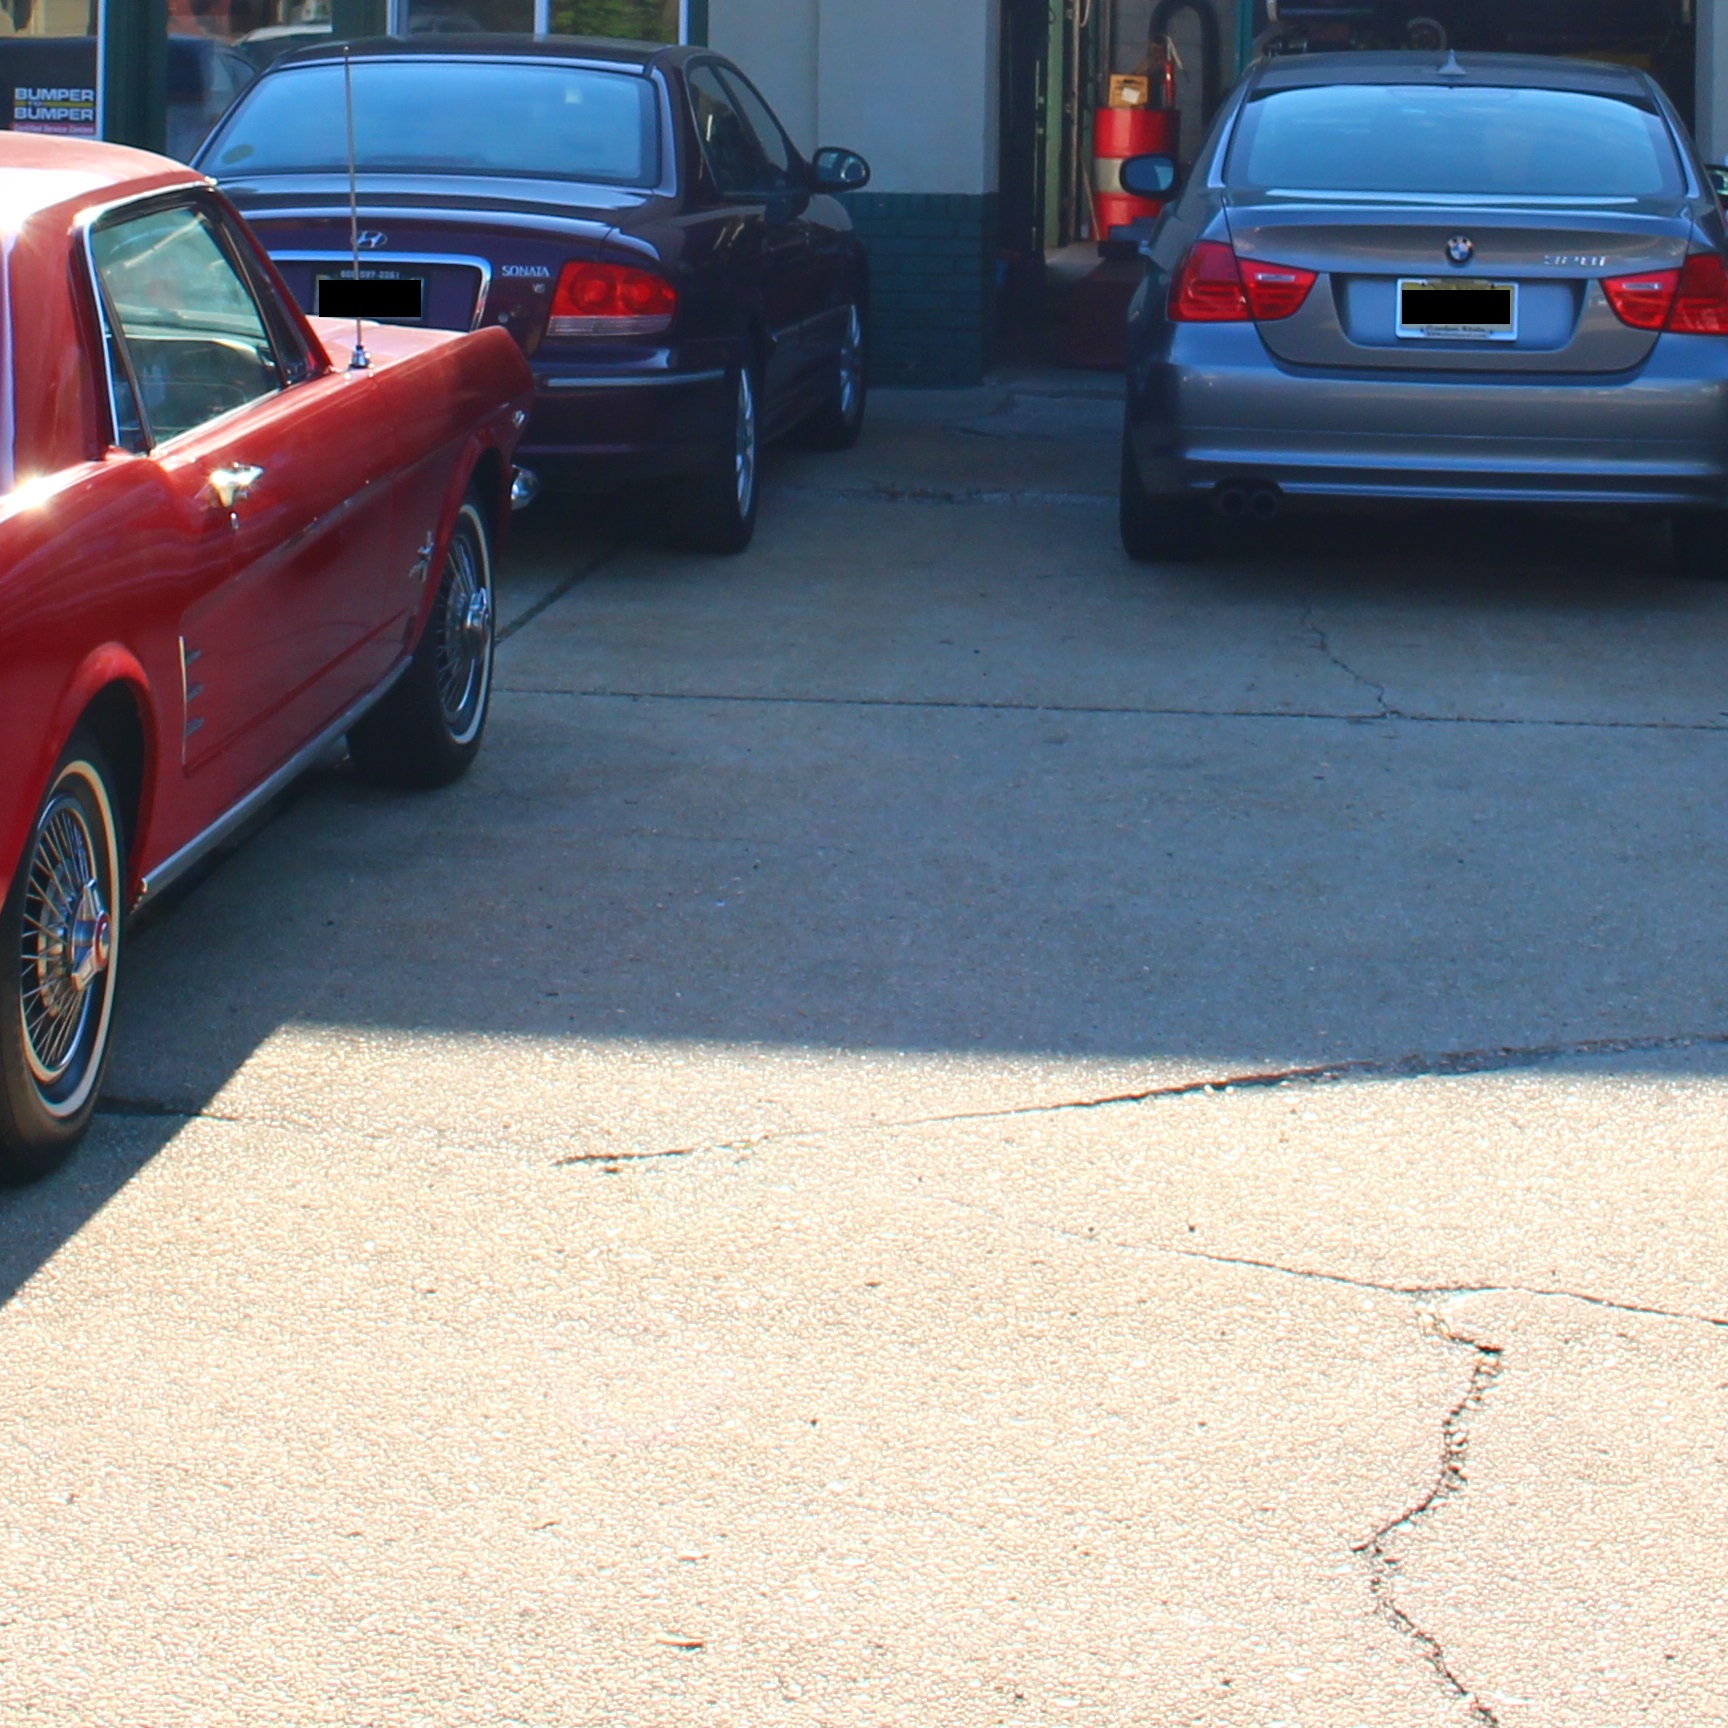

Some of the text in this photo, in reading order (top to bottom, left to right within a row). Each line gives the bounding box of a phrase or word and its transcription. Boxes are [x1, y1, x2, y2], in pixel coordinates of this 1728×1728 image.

[14, 87, 94, 101] BUMPER
[14, 106, 94, 120] BUMPER
[501, 264, 550, 278] SONATA
